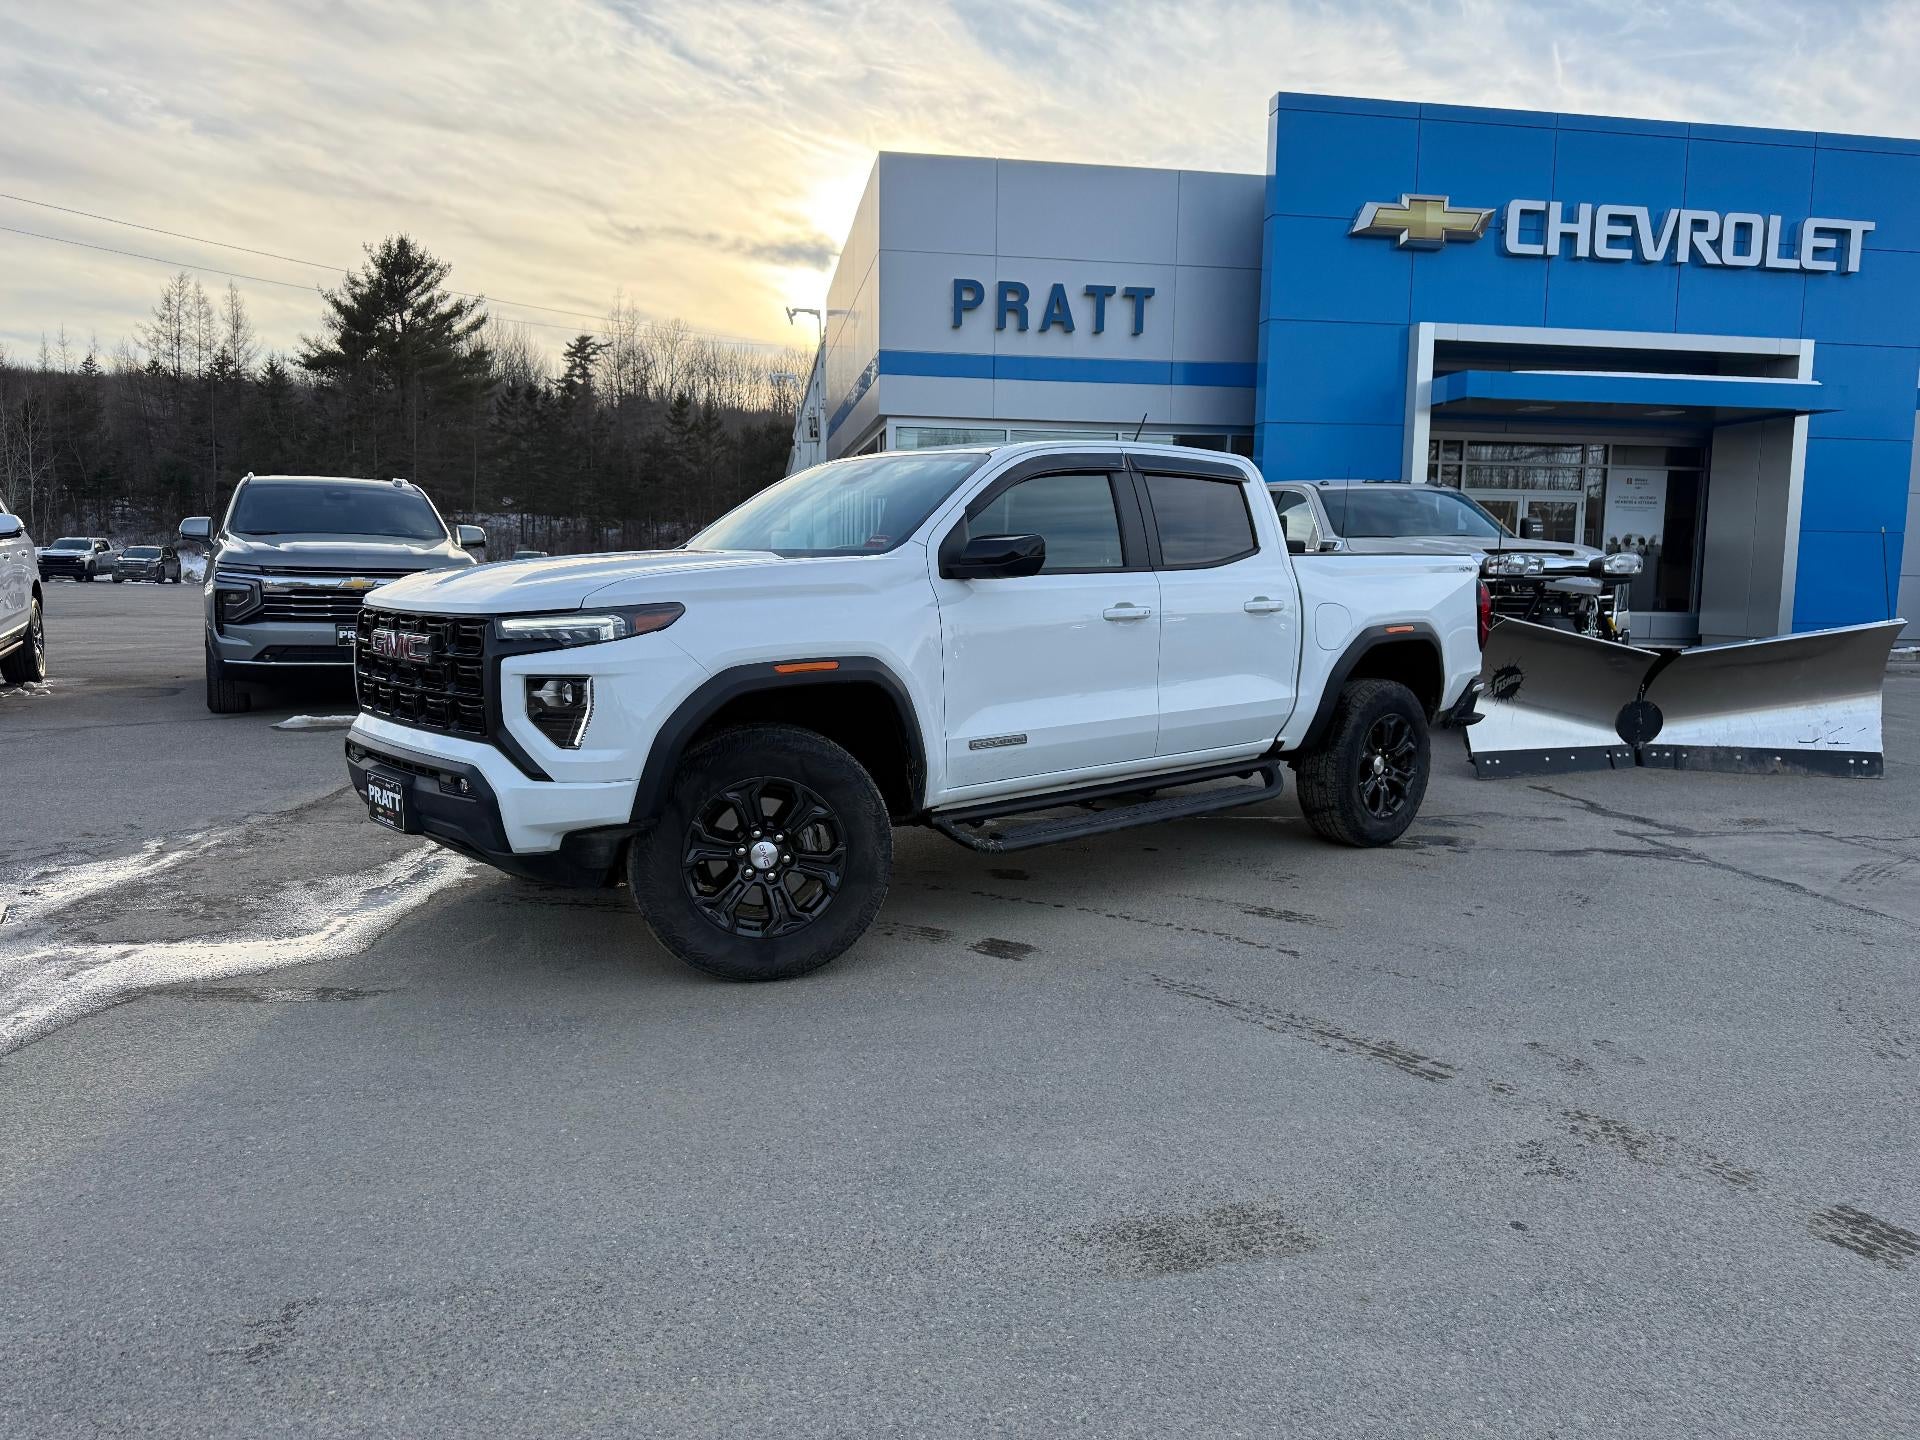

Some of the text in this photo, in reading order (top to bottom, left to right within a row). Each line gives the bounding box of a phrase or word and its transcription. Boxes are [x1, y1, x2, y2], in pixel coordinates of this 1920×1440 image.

[1504, 198, 1876, 274] CHEVROLET
[952, 278, 1156, 336] PRATT
[371, 628, 431, 664] GMC
[368, 783, 401, 812] PRATT
